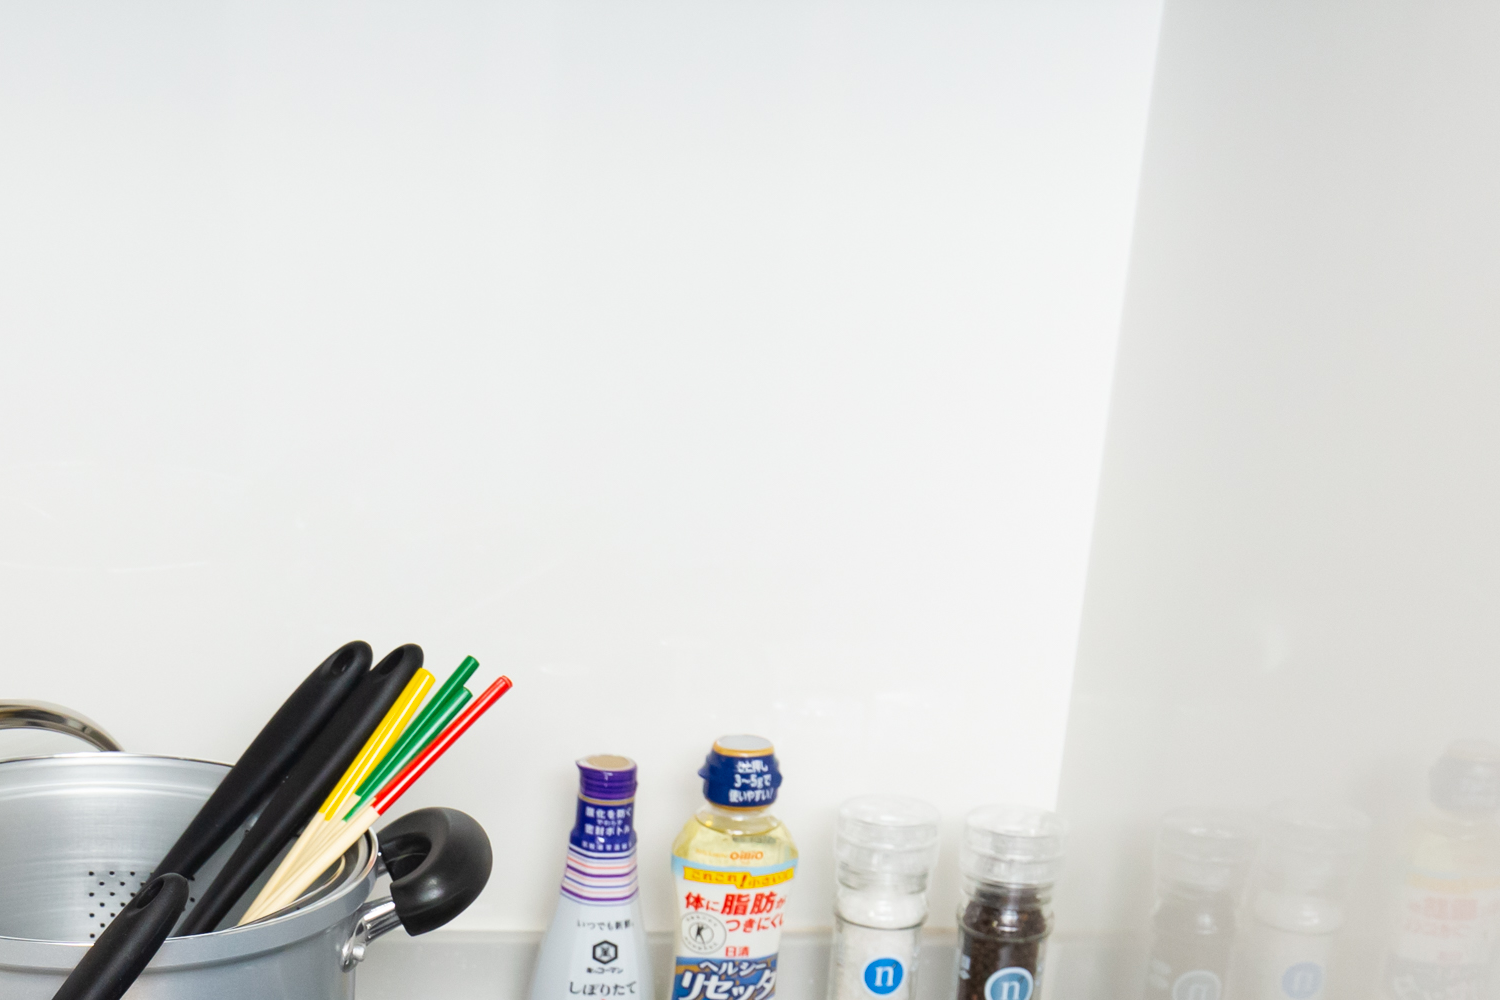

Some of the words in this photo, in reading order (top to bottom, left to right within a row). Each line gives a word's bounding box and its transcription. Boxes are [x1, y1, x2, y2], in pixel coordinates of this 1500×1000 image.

[685, 891, 787, 916] 体に脂肪が
[699, 961, 767, 977] ヘルシー
